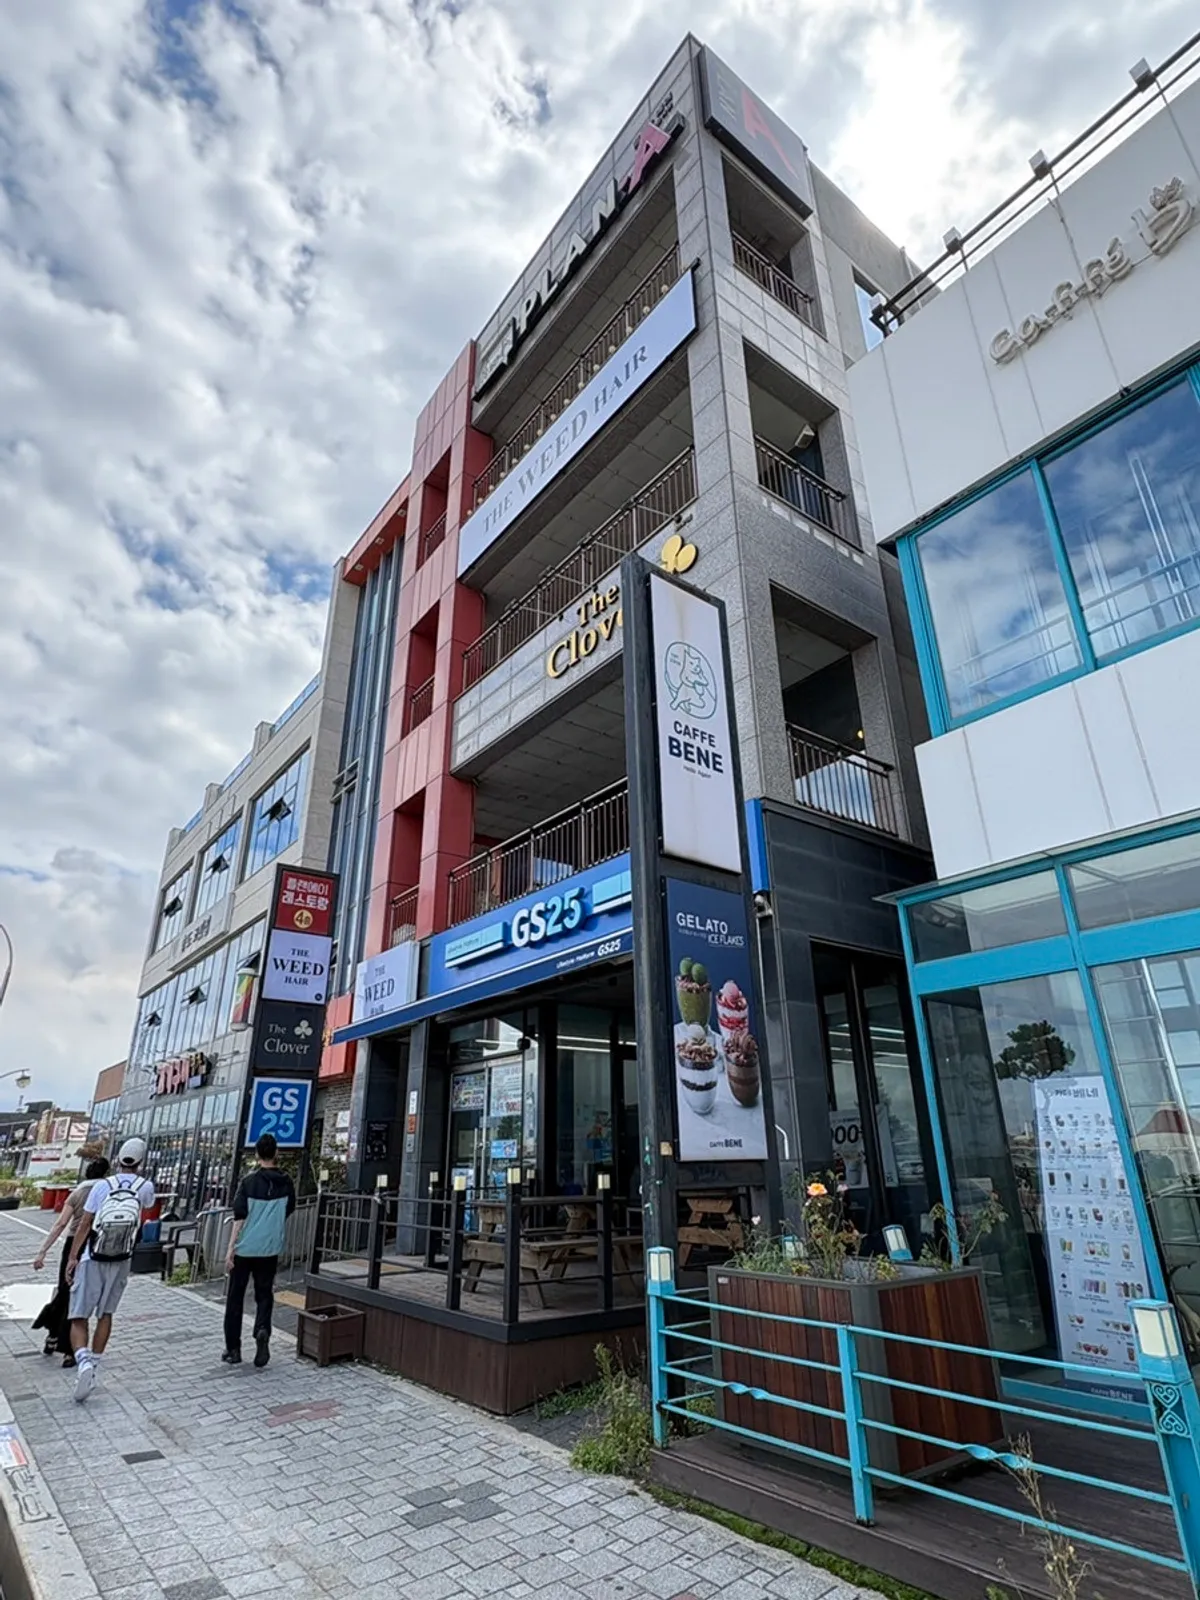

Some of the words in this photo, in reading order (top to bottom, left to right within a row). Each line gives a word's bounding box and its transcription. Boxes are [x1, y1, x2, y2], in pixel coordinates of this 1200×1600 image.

[519, 178, 619, 335] PLAN
[618, 121, 671, 194] A
[484, 491, 513, 533] THE
[518, 409, 588, 494] WEED
[594, 345, 648, 414] HAIR
[577, 585, 619, 627] The
[673, 720, 717, 748] CAFFE
[668, 735, 724, 774] BENE
[511, 887, 584, 948] GS25
[676, 912, 728, 935] GELATO
[598, 939, 621, 957] GS25
[708, 933, 719, 944] ICE
[291, 948, 310, 958] THE
[273, 957, 325, 976] WEED
[284, 977, 309, 986] HAIR
[364, 978, 395, 1003] WEED
[268, 1023, 287, 1035] The
[263, 1037, 310, 1055] Clover
[262, 1086, 300, 1112] GS
[259, 1112, 296, 1139] 25
[724, 1138, 743, 1148] BENE
